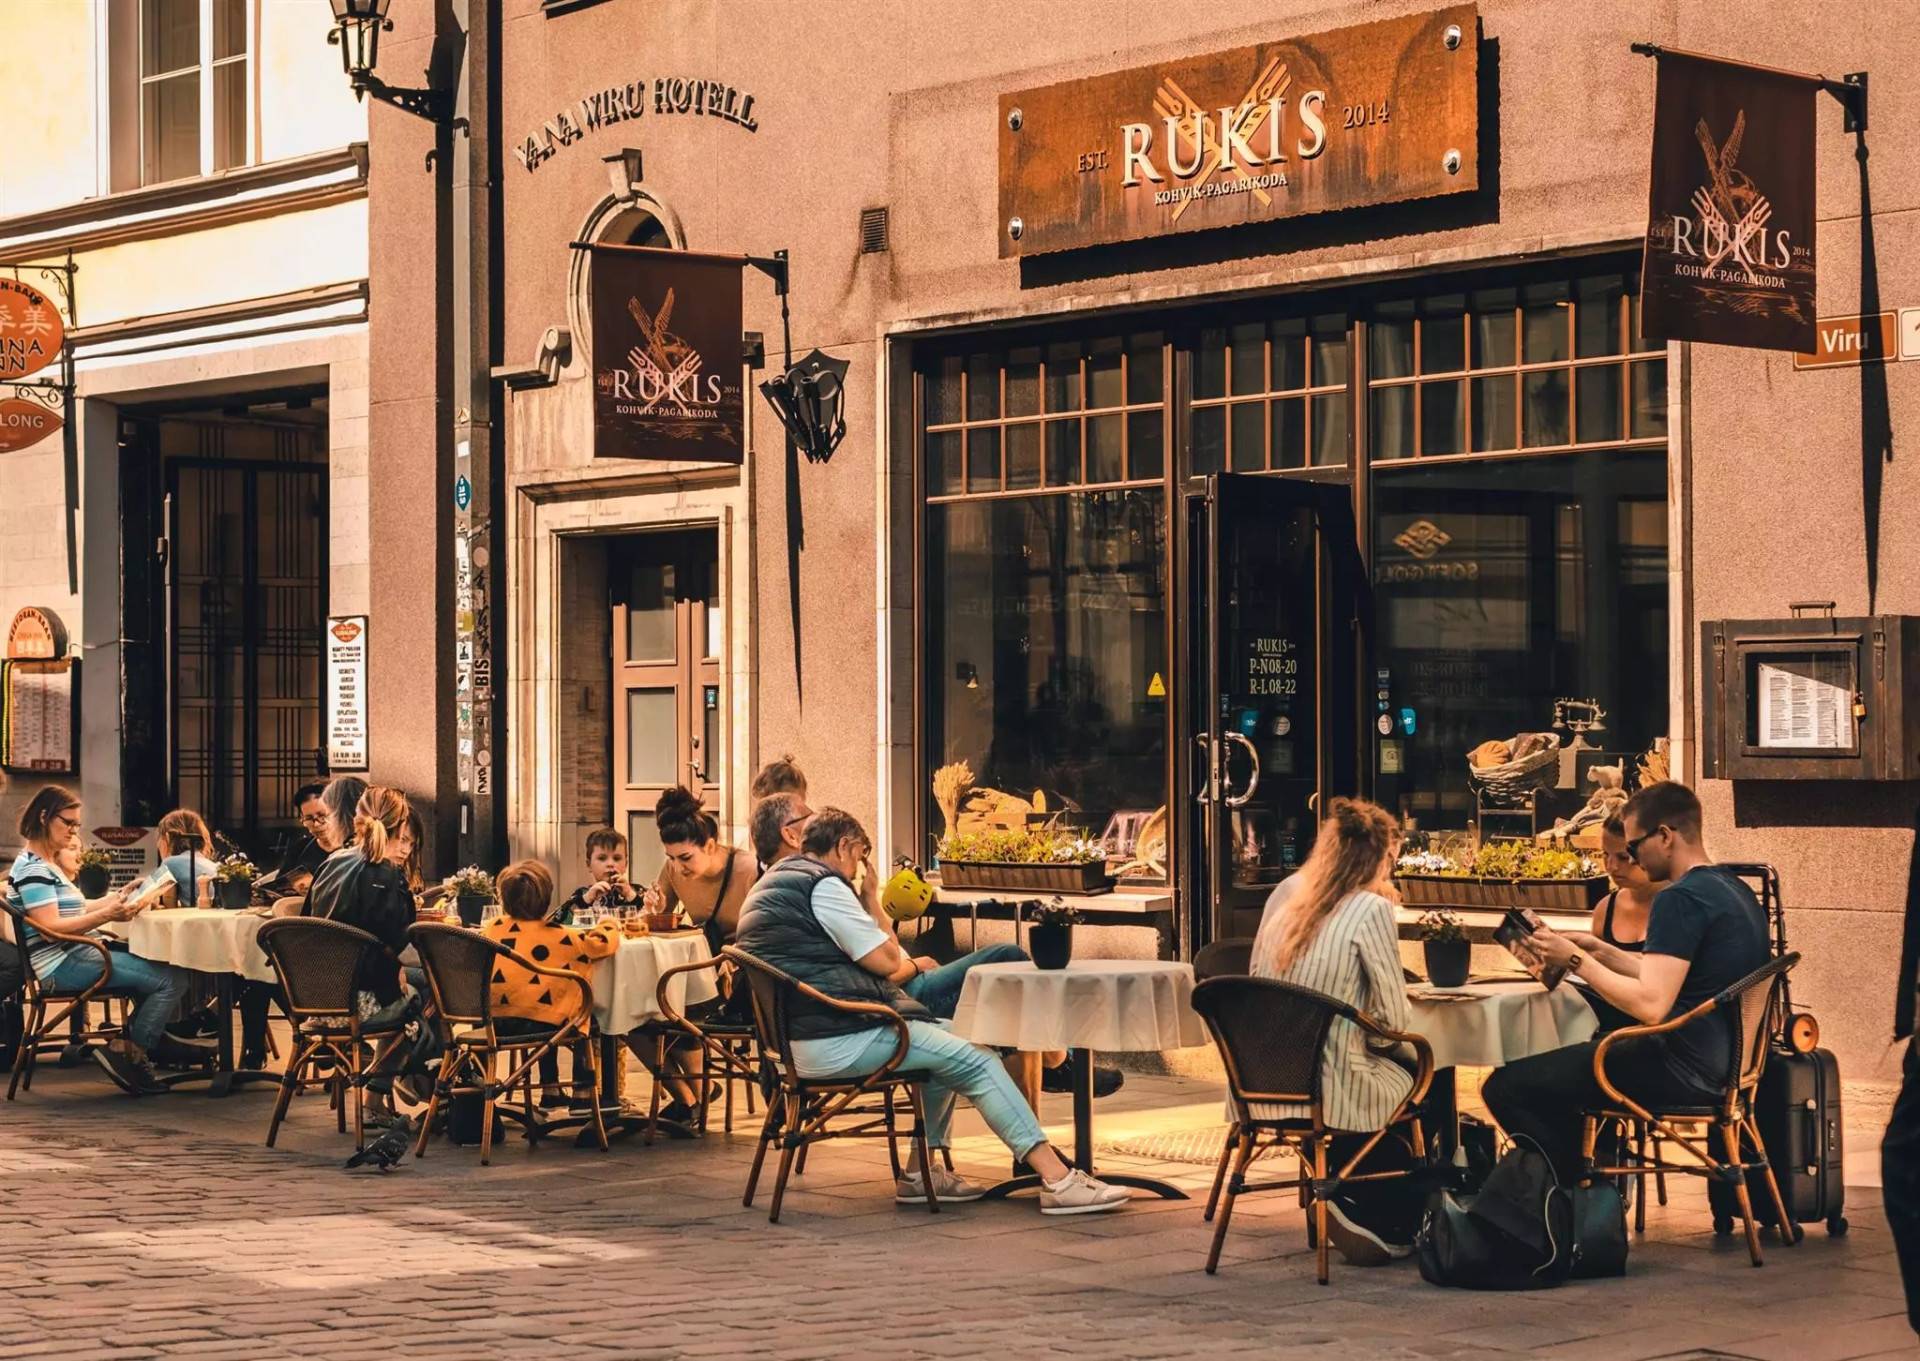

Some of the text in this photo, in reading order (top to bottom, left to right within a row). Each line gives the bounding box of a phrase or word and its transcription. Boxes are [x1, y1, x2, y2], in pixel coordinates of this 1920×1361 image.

[514, 108, 583, 172] VANA
[651, 77, 758, 132] HOTELL
[1077, 91, 1390, 188] EST. RUKIS 2014
[1155, 172, 1288, 205] KOHVIK-PAGARIKODA
[1671, 215, 1791, 269] RUKIS
[1792, 246, 1811, 257] 2014
[1822, 328, 1869, 353] Viru
[612, 369, 721, 404] RUKIS
[1257, 639, 1287, 652] RUKIS
[1269, 659, 1297, 674] 08-20
[1250, 678, 1296, 694] R-L 08-22
